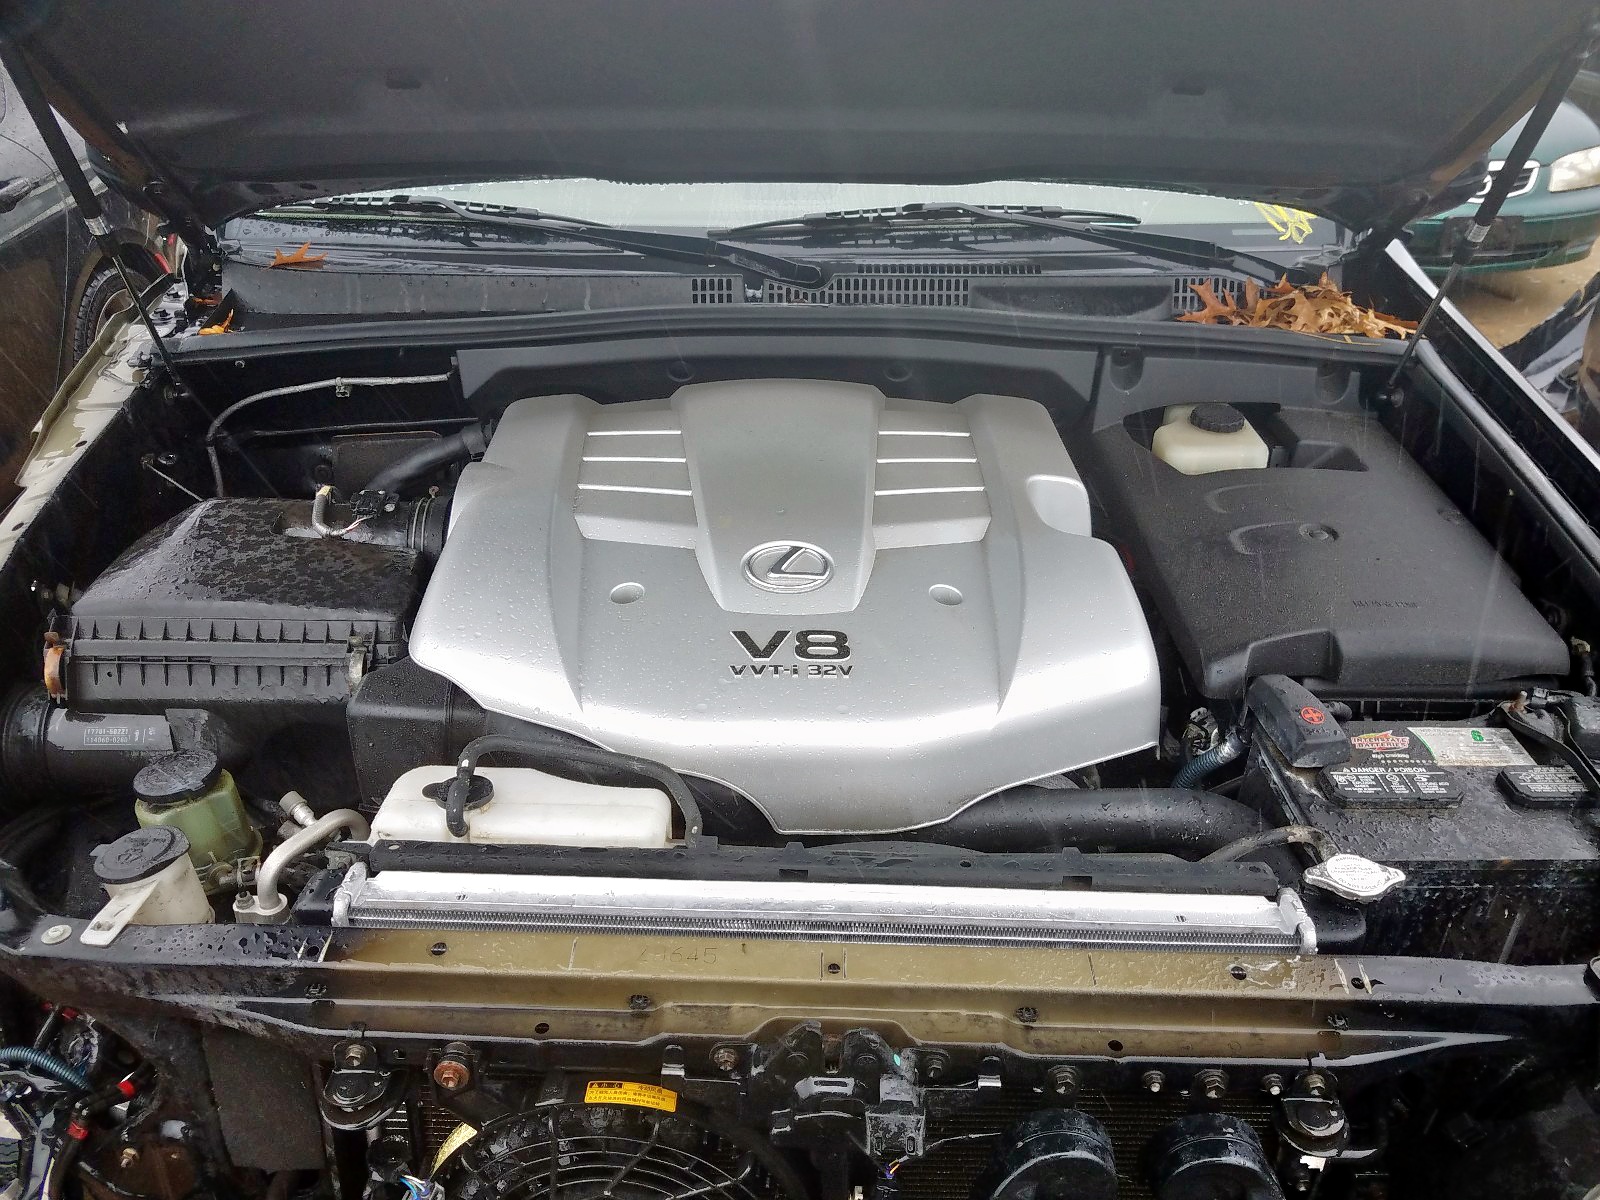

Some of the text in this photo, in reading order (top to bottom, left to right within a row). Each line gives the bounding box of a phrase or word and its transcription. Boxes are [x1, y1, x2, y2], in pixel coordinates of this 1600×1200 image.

[730, 630, 851, 661] V8
[730, 664, 853, 679] VVT-i 32V
